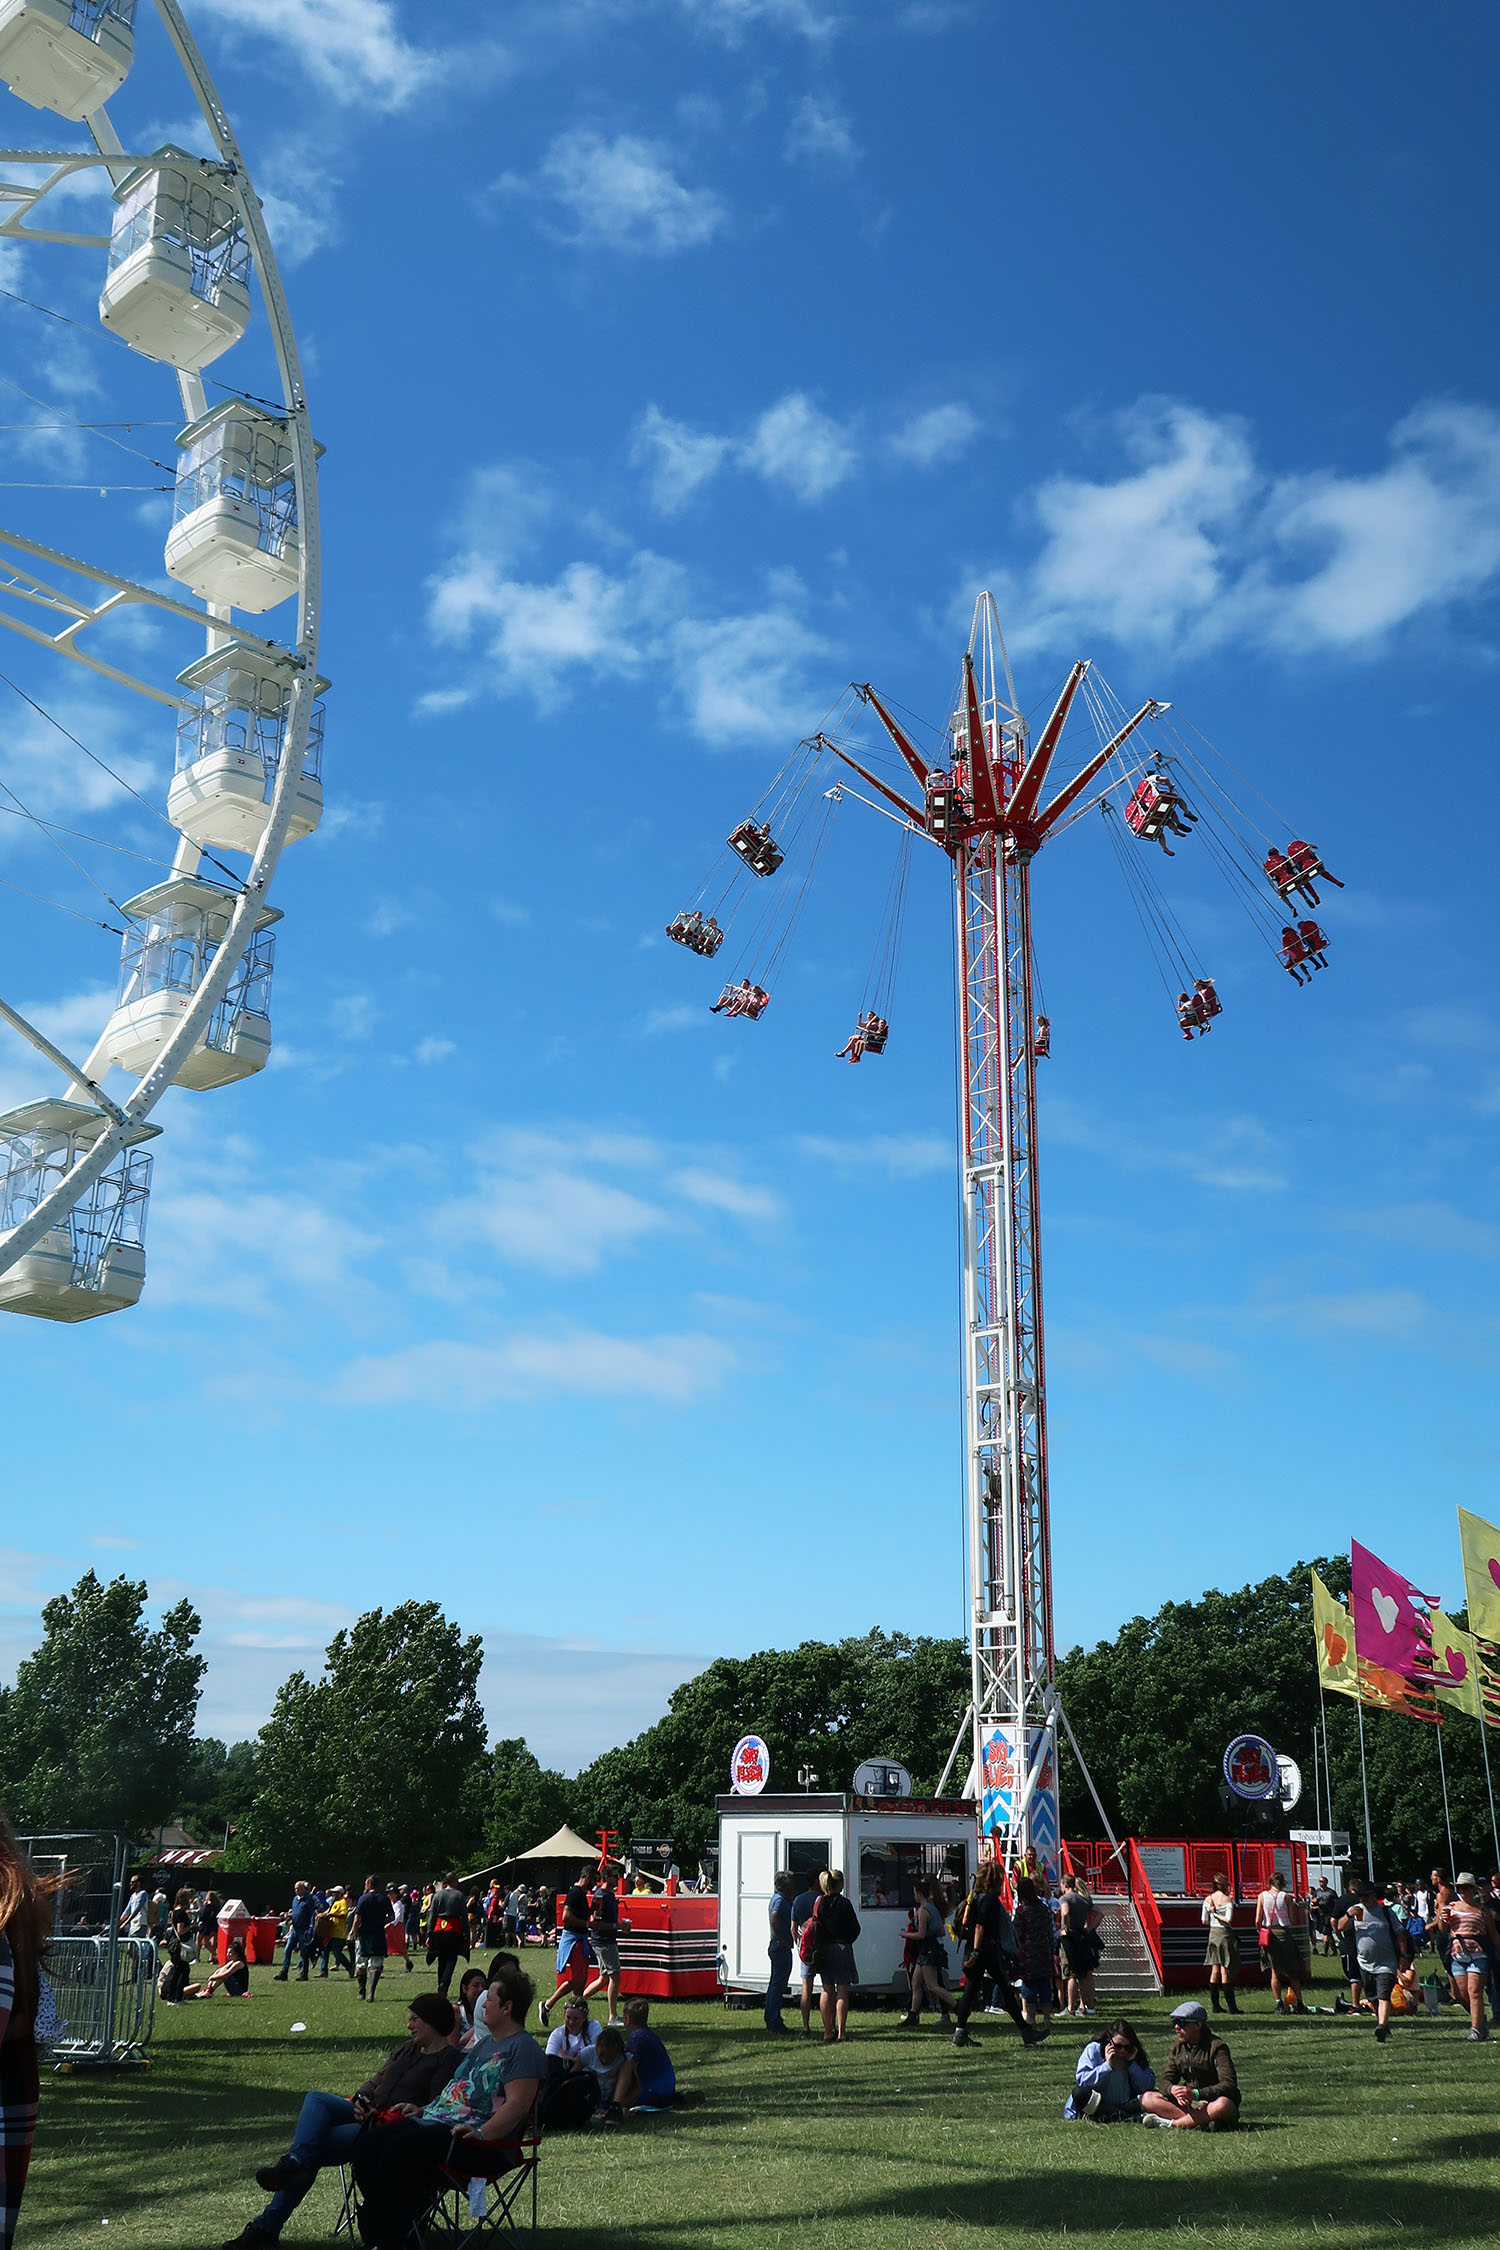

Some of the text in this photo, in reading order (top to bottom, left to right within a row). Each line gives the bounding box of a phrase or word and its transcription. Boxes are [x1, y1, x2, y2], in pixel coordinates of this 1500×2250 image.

[988, 1739, 1008, 1765] SKY
[982, 1764, 1015, 1791] FLYER
[1298, 1832, 1325, 1841] Tobacco
